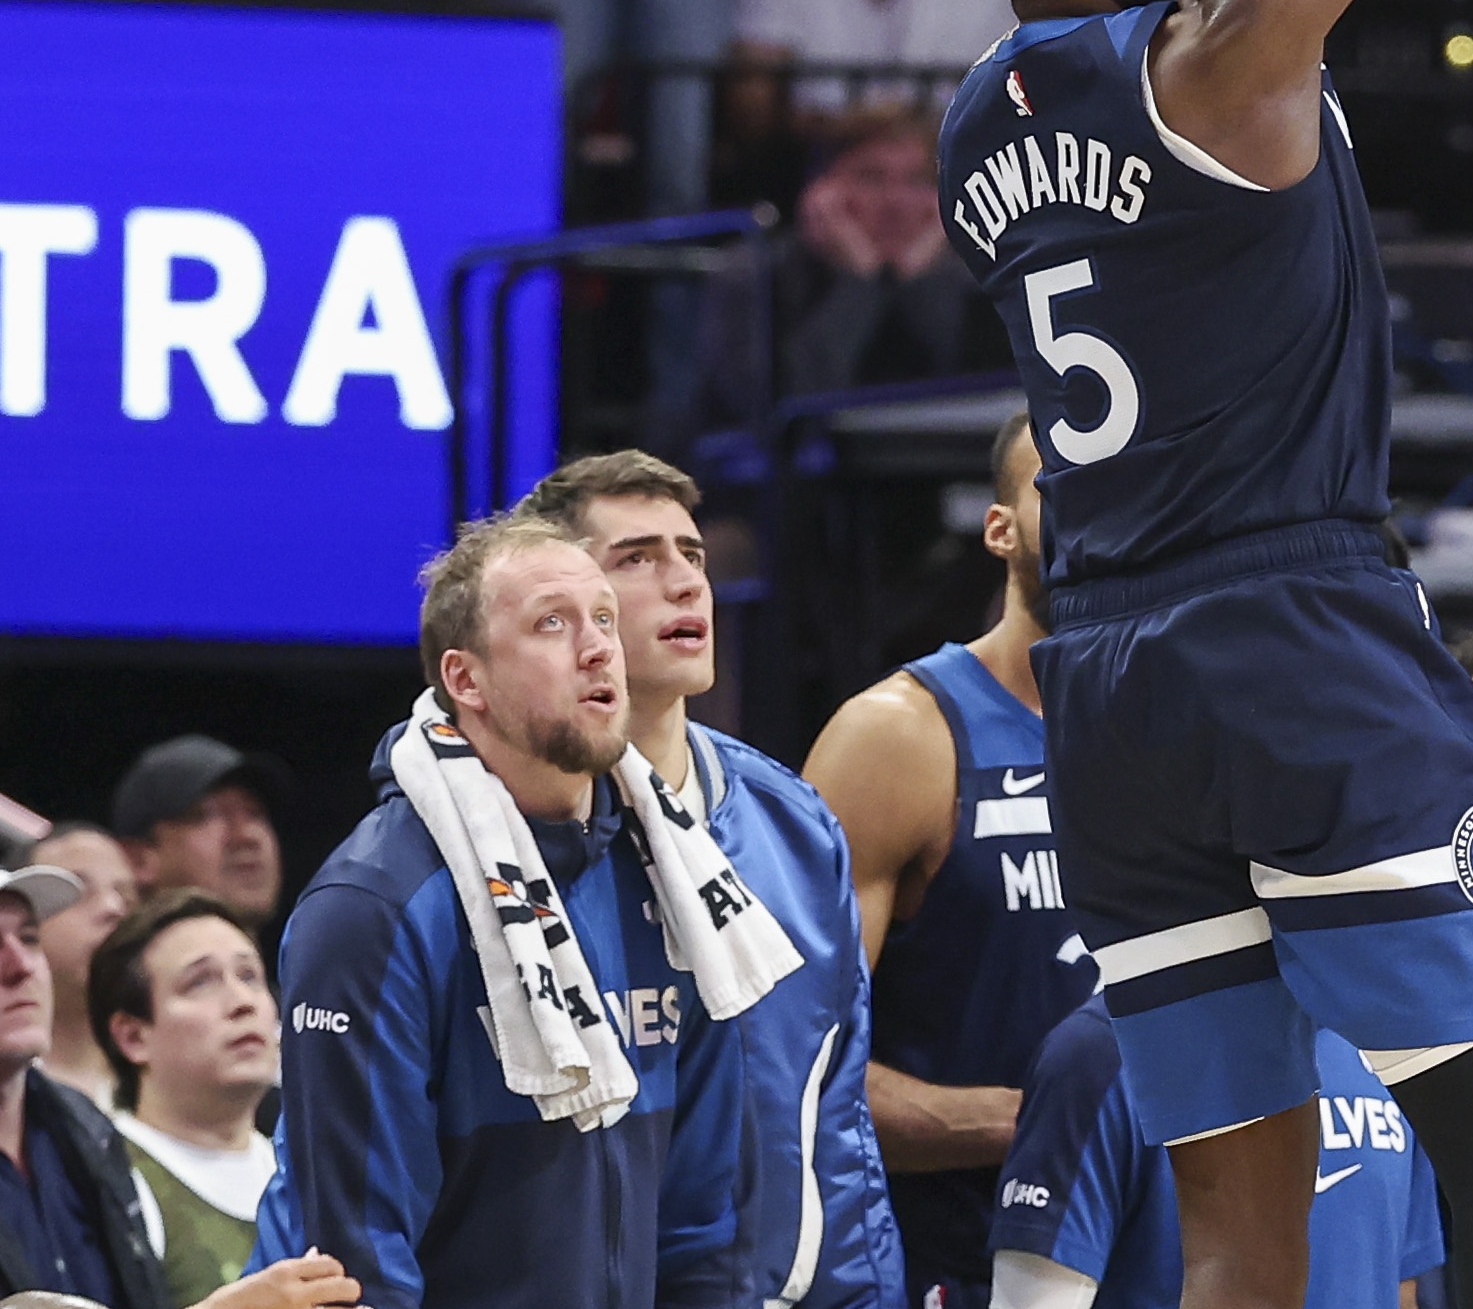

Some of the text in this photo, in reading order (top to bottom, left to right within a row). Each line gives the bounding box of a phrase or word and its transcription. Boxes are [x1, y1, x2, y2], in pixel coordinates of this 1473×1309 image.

[954, 131, 1152, 262] EDWARDS
[1024, 258, 1139, 465] 5
[305, 1006, 351, 1034] UHC
